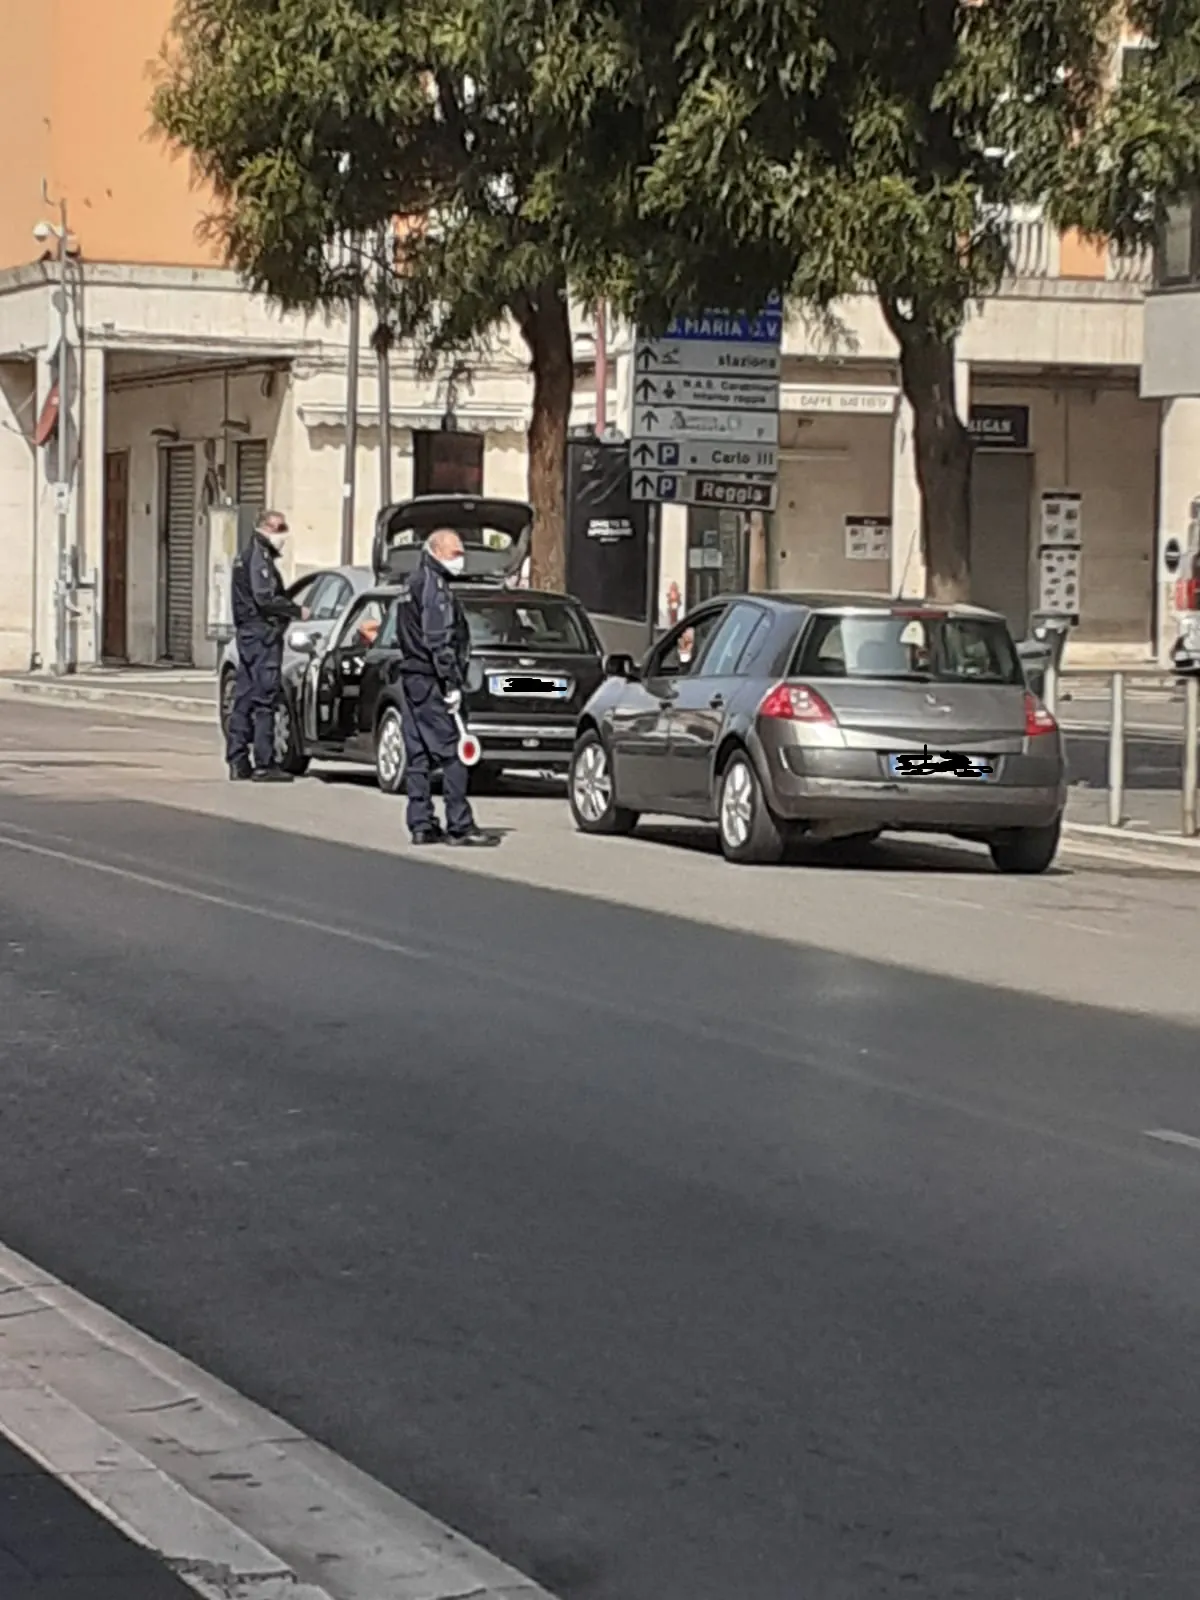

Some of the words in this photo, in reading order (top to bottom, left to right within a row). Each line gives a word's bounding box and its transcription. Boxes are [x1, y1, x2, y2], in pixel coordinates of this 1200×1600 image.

[661, 445, 676, 464] P
[711, 449, 751, 465] Carlo
[660, 478, 674, 496] P
[702, 481, 764, 503] Reggia
